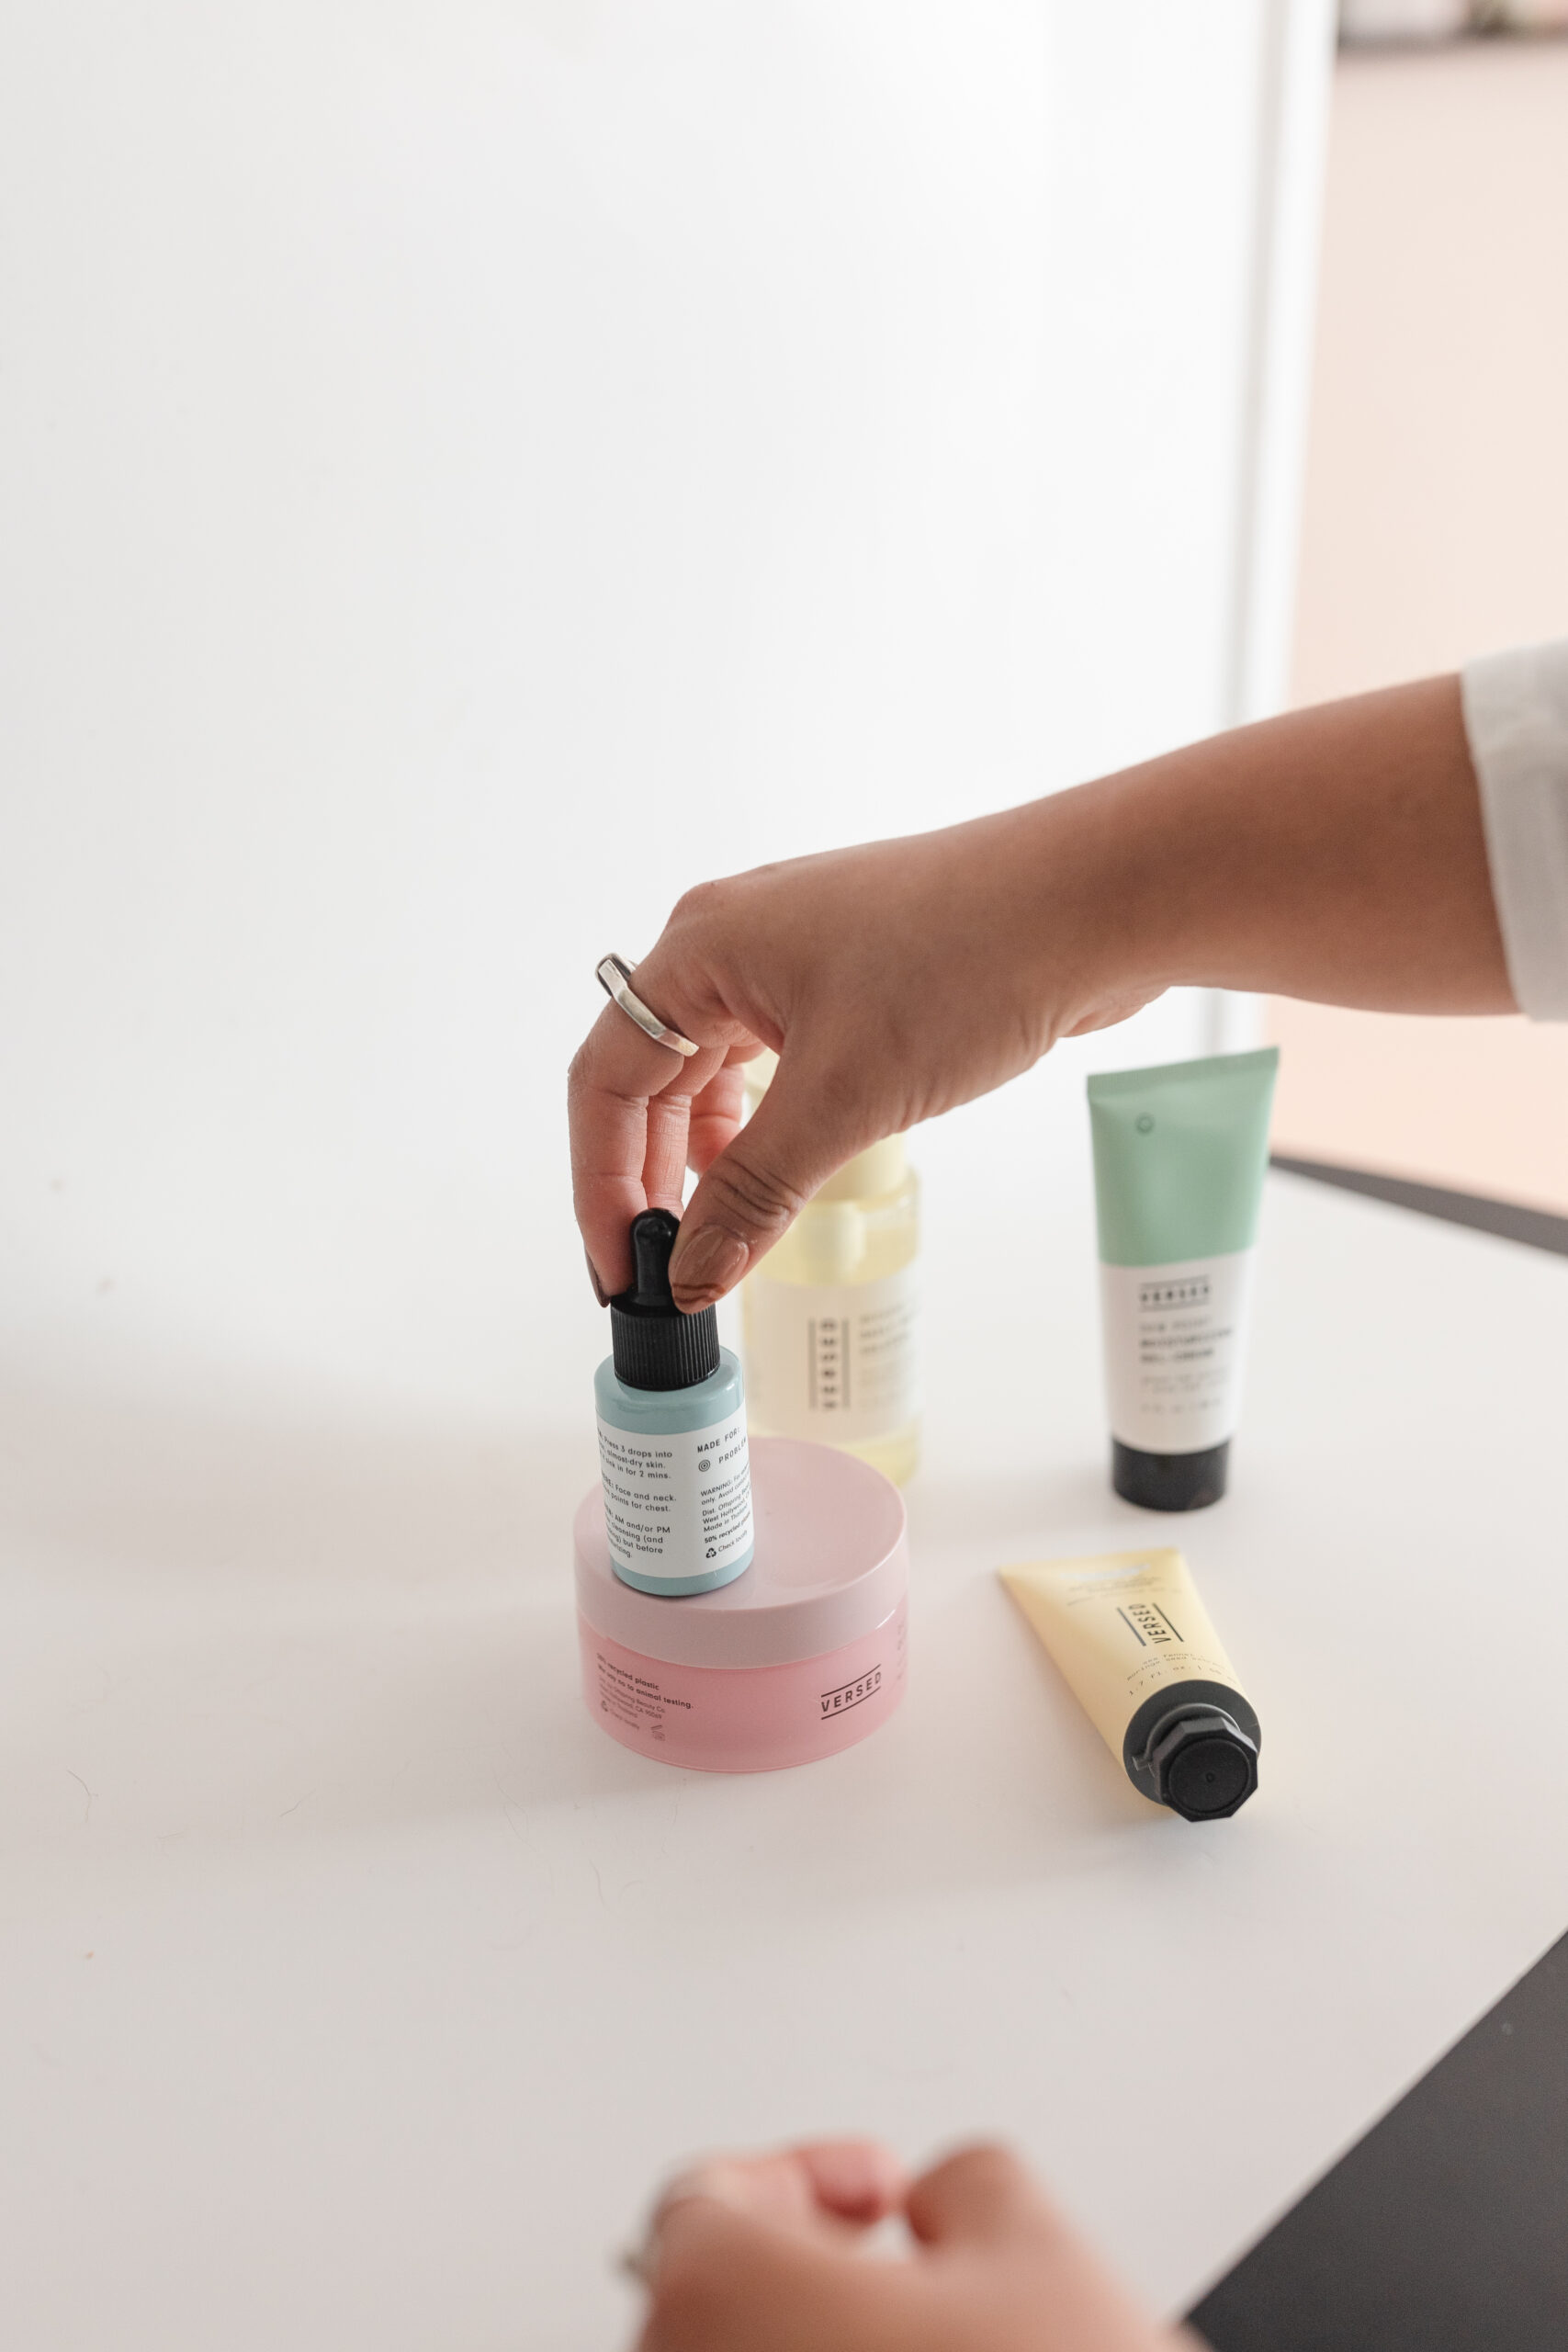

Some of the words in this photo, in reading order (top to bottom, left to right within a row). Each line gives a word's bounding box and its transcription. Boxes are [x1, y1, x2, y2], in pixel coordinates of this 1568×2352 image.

[697, 1438, 721, 1453] MADE
[628, 1448, 652, 1458] drops
[626, 1467, 637, 1476] for
[615, 1484, 631, 1497] Face
[653, 1494, 676, 1502] neck.
[631, 1501, 642, 1510] for
[615, 1514, 625, 1524] AM
[626, 1521, 653, 1532] and/or
[702, 1515, 719, 1524] West
[704, 1522, 723, 1532] Made
[643, 1535, 663, 1544] (and
[705, 1535, 717, 1544] 50%
[636, 1544, 663, 1554] before
[1128, 1603, 1172, 1644] VERSED
[635, 1677, 660, 1690] plastic
[820, 1671, 881, 1713] VERSED
[636, 1689, 661, 1702] animal
[663, 1697, 694, 1710] testing.
